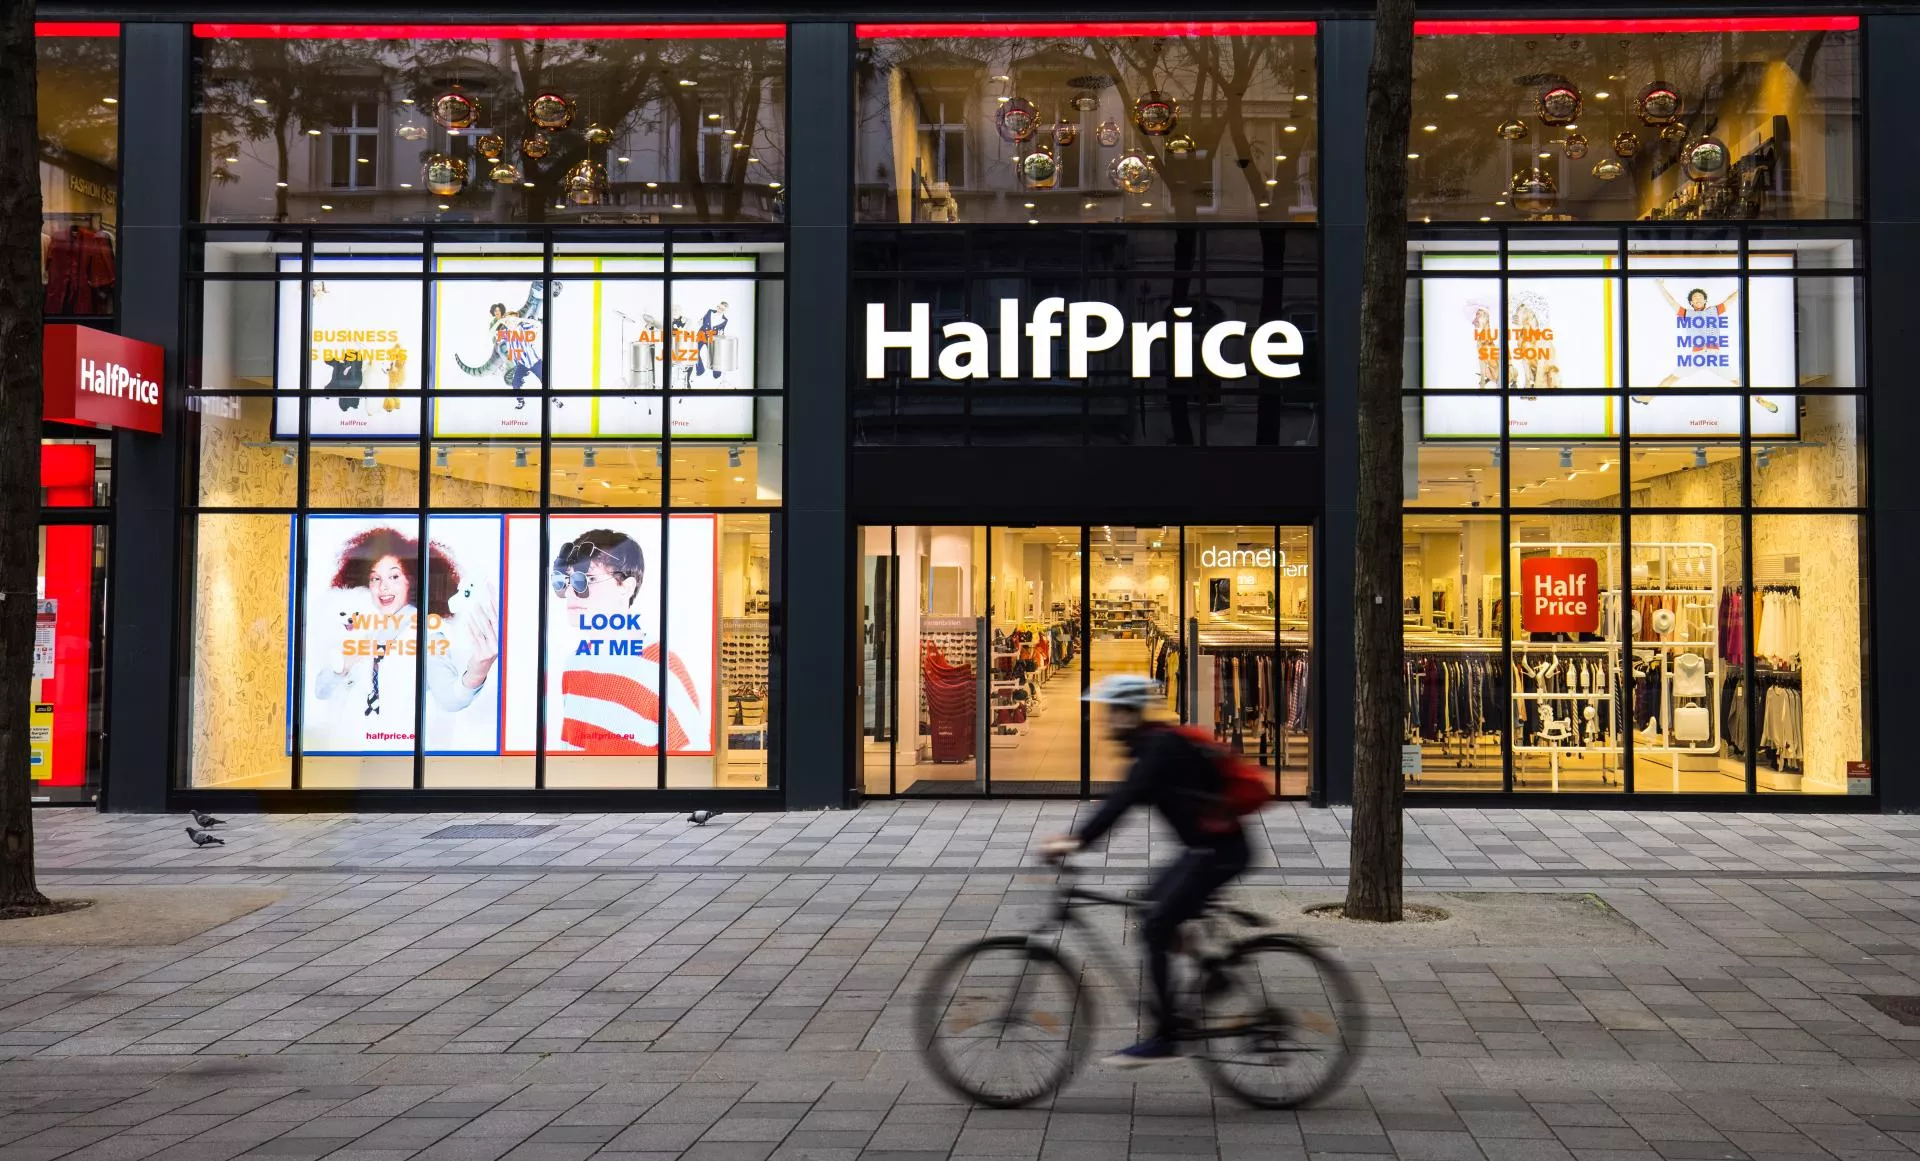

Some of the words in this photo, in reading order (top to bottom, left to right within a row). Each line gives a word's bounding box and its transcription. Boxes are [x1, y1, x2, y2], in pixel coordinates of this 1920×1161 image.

[1676, 316, 1729, 329] MORE
[313, 330, 398, 342] BUSINESS
[497, 330, 536, 342] FIND
[672, 329, 716, 343] THAT
[866, 297, 1304, 379] HalfPrice
[1676, 335, 1729, 348] MORE
[323, 348, 408, 361] BUSINESS
[507, 349, 524, 361] IT
[1478, 347, 1550, 361] SESON
[1677, 354, 1729, 367] MORE
[80, 357, 159, 405] HalfPrice
[1201, 545, 1286, 568] damen
[1534, 573, 1587, 597] Half
[1535, 596, 1588, 616] Price
[351, 613, 404, 630] WHY
[579, 614, 641, 630] LOOK
[342, 639, 451, 656] SELFISH?
[575, 639, 604, 656] AT
[609, 639, 644, 656] ME
[366, 732, 416, 741] halfprice.e
